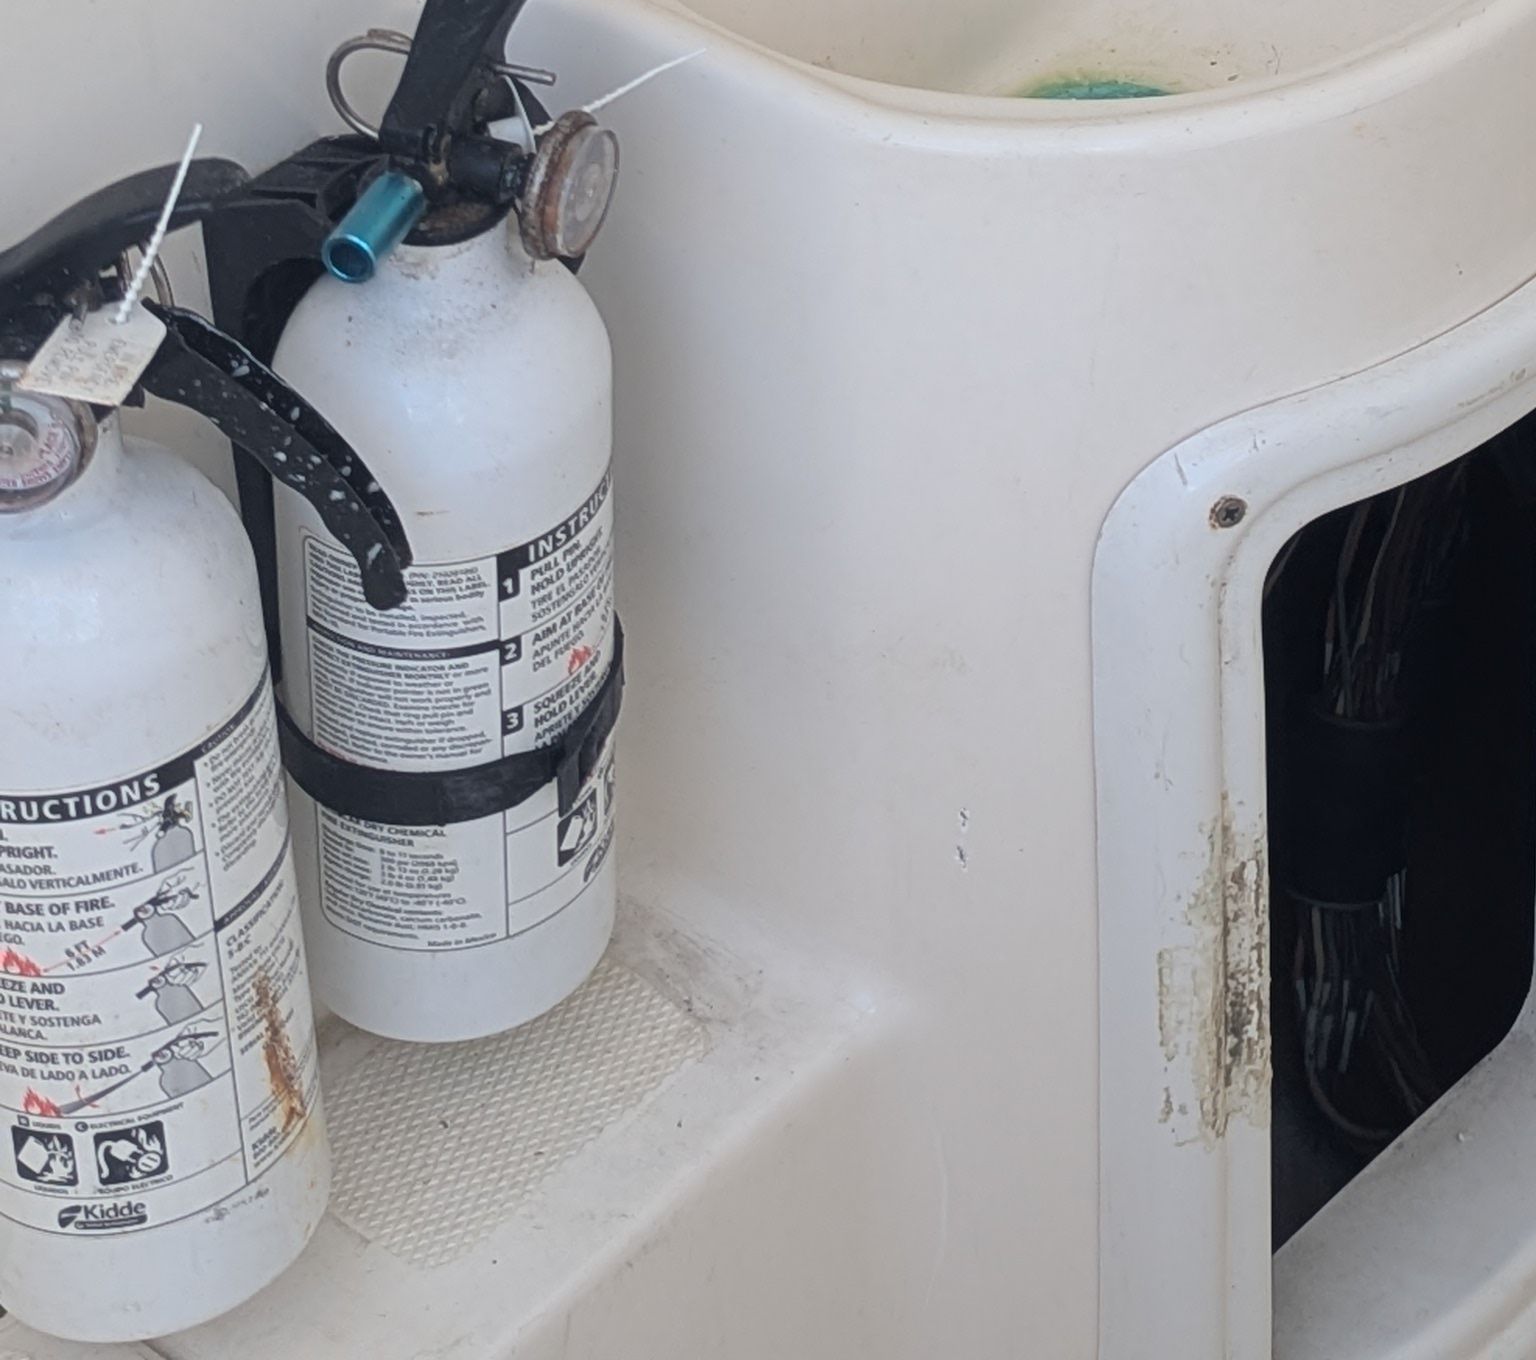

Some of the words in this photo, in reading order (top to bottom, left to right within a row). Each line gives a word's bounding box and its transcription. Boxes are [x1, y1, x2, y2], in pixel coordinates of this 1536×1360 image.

[530, 558, 559, 581] PULL
[502, 578, 513, 594] 1
[504, 643, 517, 661] 2
[506, 712, 519, 730] 3
[5, 901, 45, 916] BASE
[49, 901, 71, 916] OF
[75, 895, 115, 914] FIRE.
[4, 920, 44, 933] HACIA
[48, 920, 66, 934] LA
[69, 916, 105, 932] BASE
[74, 940, 91, 954] FT
[30, 982, 65, 996] AND
[9, 995, 60, 1012] LEVER.
[19, 1015, 27, 1026] Y
[30, 1013, 102, 1028] SOSTENGA
[26, 1050, 60, 1065] SIDE
[62, 1052, 84, 1066] TO
[88, 1046, 130, 1064] SIDE.
[21, 1066, 37, 1079] DE
[40, 1068, 76, 1082] LADO
[78, 1070, 90, 1081] A
[82, 1200, 147, 1220] Kidde
